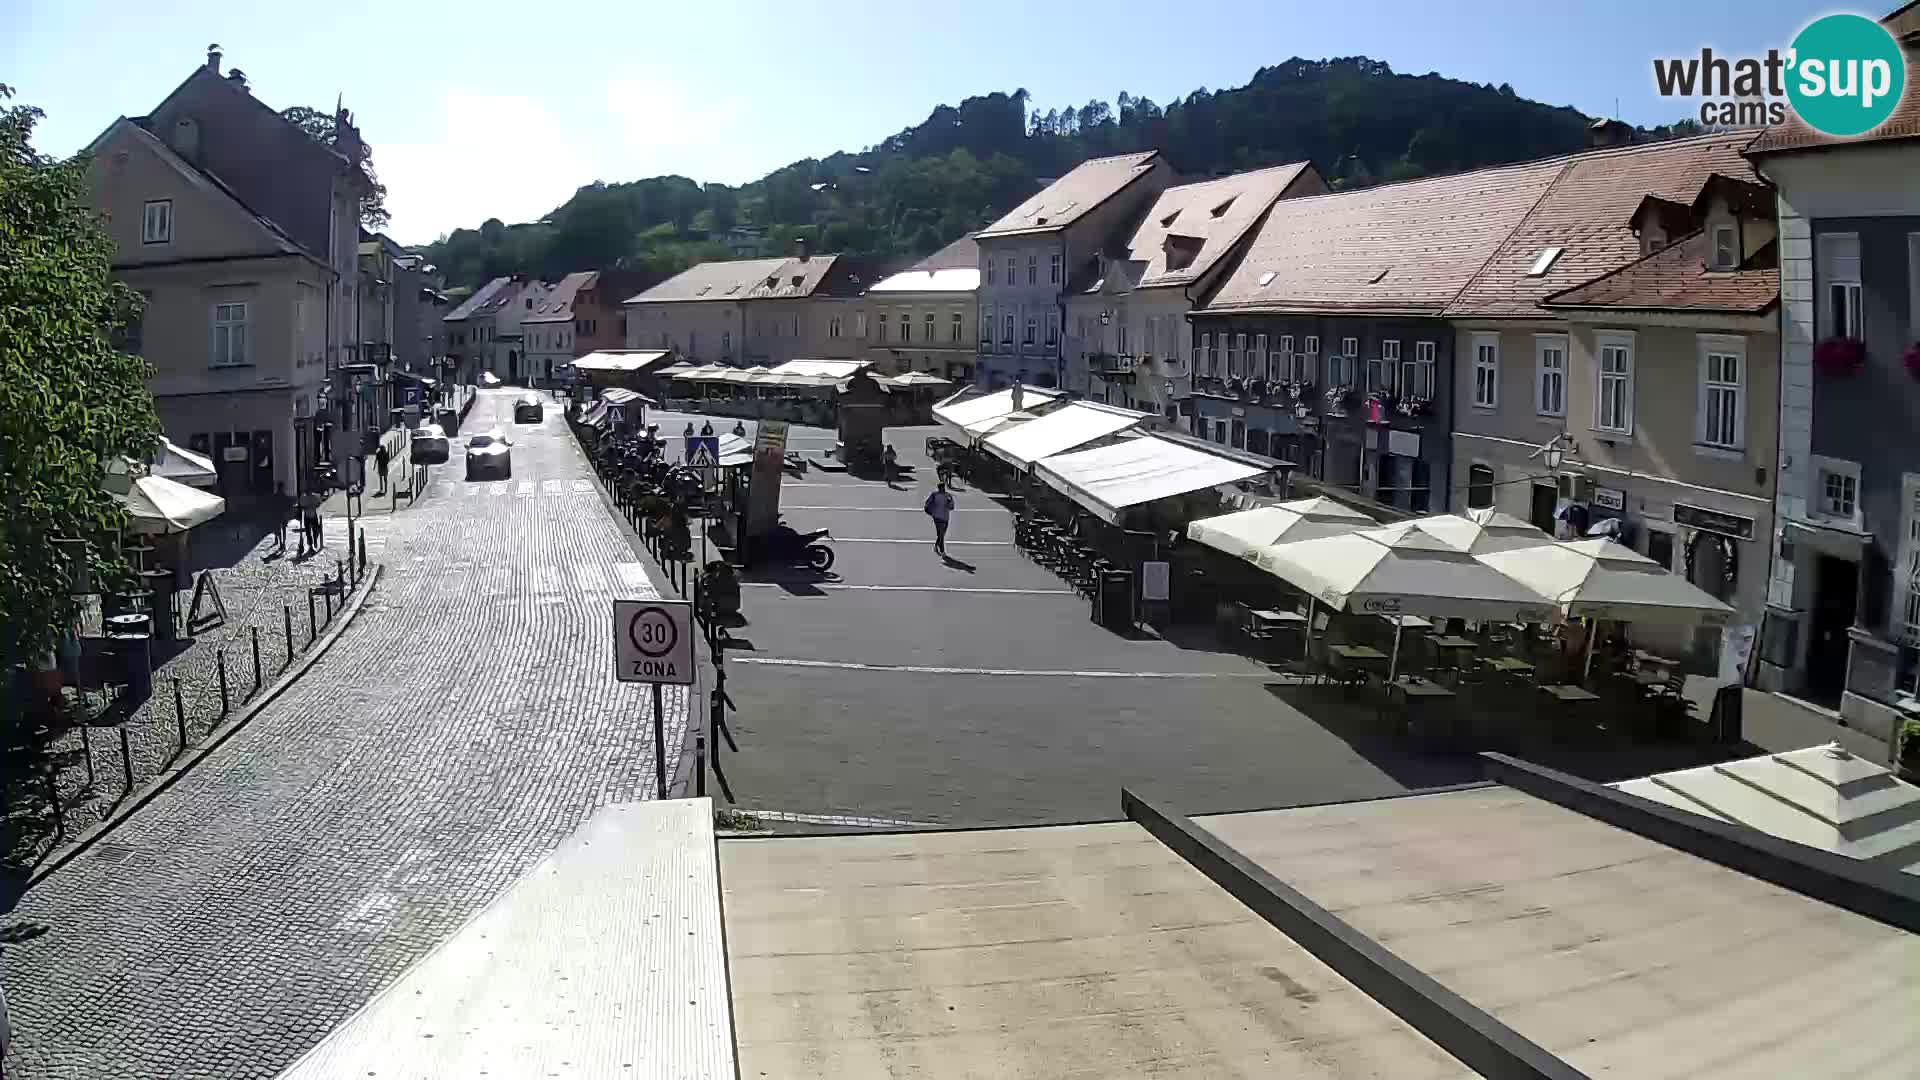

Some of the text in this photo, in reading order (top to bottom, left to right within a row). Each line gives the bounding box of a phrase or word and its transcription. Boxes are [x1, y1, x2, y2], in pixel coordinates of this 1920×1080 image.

[407, 391, 415, 401] P
[643, 624, 666, 643] 30
[632, 661, 676, 676] ZONA
